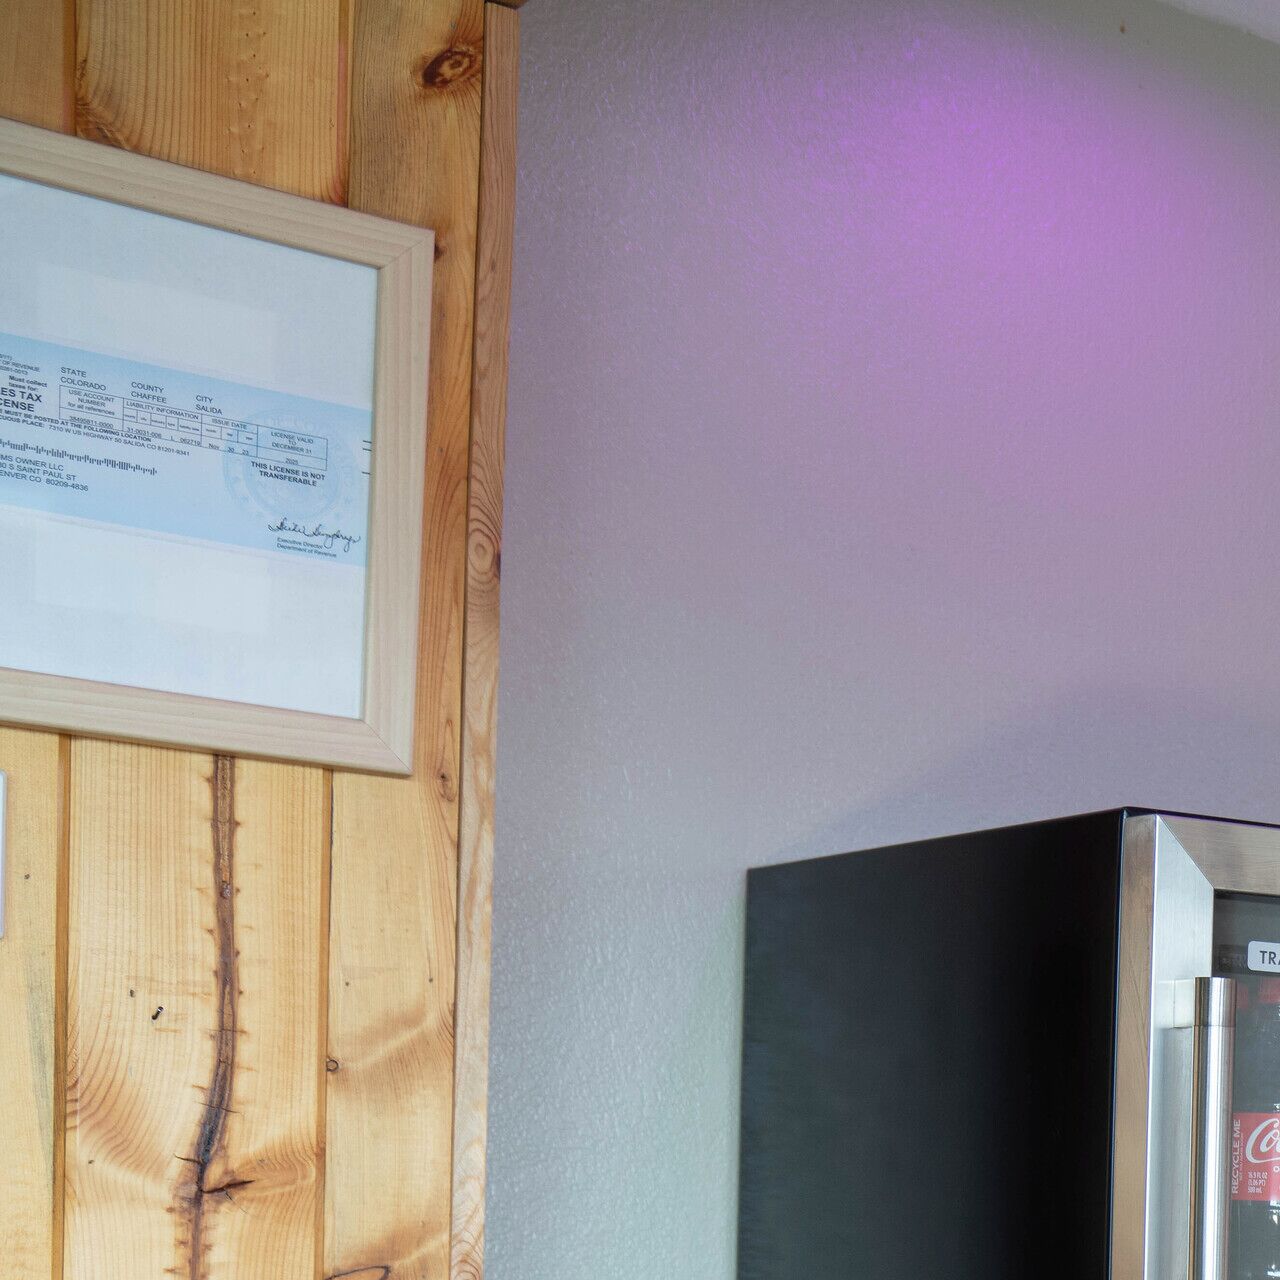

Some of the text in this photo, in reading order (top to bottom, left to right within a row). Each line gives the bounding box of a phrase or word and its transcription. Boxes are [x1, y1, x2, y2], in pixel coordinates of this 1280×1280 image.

[60, 366, 87, 378] STATE
[26, 379, 47, 387] collect
[60, 376, 107, 391] COLORADO
[131, 381, 164, 393] COUNTY
[19, 390, 42, 402] TAX
[77, 397, 106, 407] NUMBER
[83, 392, 115, 403] ACCOUNT
[131, 391, 167, 404] CHAFFEE
[196, 394, 213, 404] CITY
[126, 401, 154, 411] LIABILITY
[156, 406, 199, 420] INFORMATION
[195, 403, 223, 415] SALIDA
[34, 415, 60, 425] POSTED
[83, 425, 120, 436] FOLLOWING
[121, 432, 152, 442] LOCATION
[231, 421, 248, 430] DATE
[270, 431, 295, 440] LICENSE
[123, 438, 146, 448] SALIDA
[15, 456, 47, 468] OWNER
[48, 462, 64, 471] LLC
[16, 465, 41, 475] SAINT
[42, 470, 64, 480] PAUL
[65, 473, 76, 482] ST
[251, 460, 268, 470] THIS
[269, 465, 301, 477] LICENSE
[310, 473, 326, 481] NOT
[29, 475, 42, 483] CO
[259, 469, 318, 487] TRANSFERABLE
[277, 543, 307, 553] Department
[314, 549, 337, 558] Revenue
[1231, 1119, 1241, 1194] RECYCLE ME
